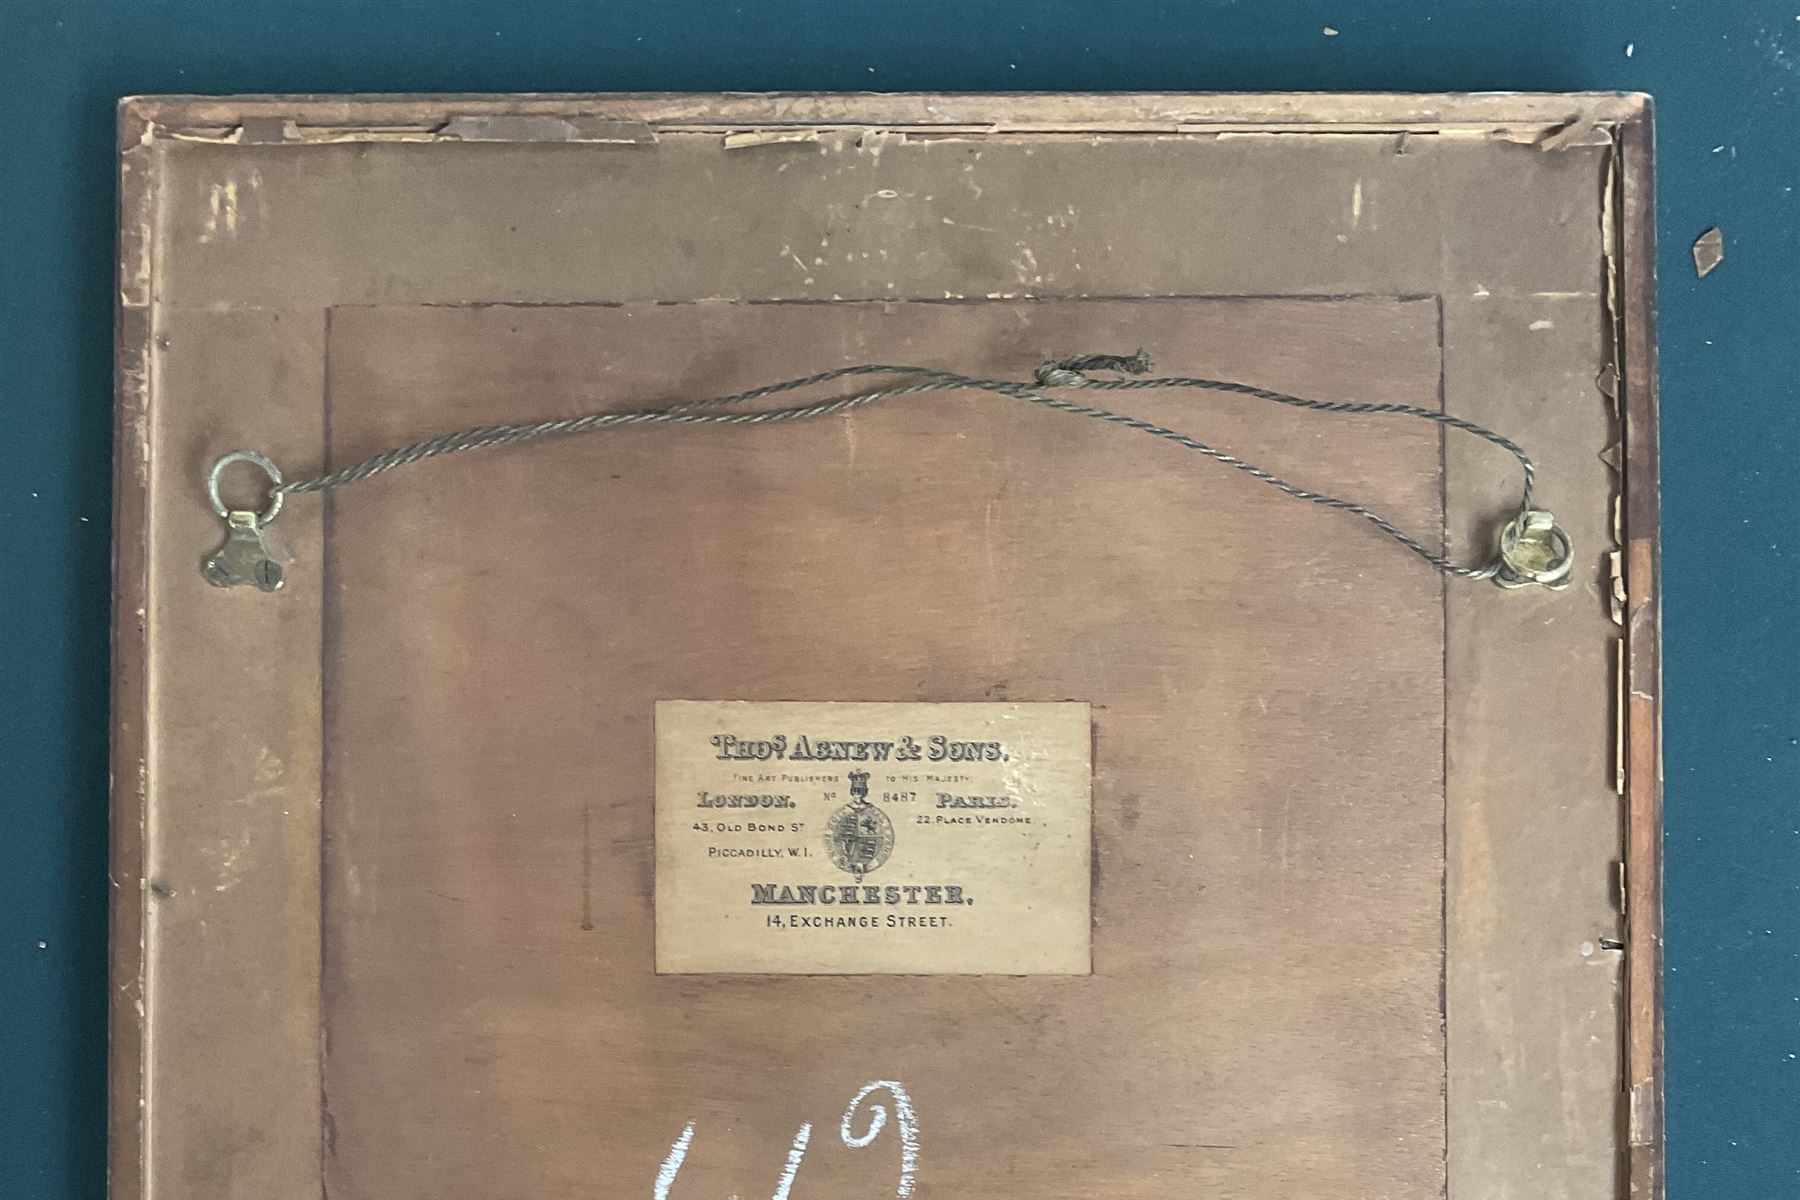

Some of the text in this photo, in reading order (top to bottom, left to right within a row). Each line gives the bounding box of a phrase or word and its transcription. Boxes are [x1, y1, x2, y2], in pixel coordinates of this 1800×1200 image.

[789, 735, 894, 761] AGNEW
[895, 735, 922, 761] &
[758, 774, 776, 782] ART
[782, 774, 839, 783] PUBLISHERS
[697, 791, 797, 808] LONDON.
[882, 791, 917, 803] 8487
[936, 815, 972, 825] PLACE
[717, 823, 742, 832] OLD
[748, 822, 785, 832] BOND
[766, 914, 953, 929] 14, EXCHANGE STREET.
